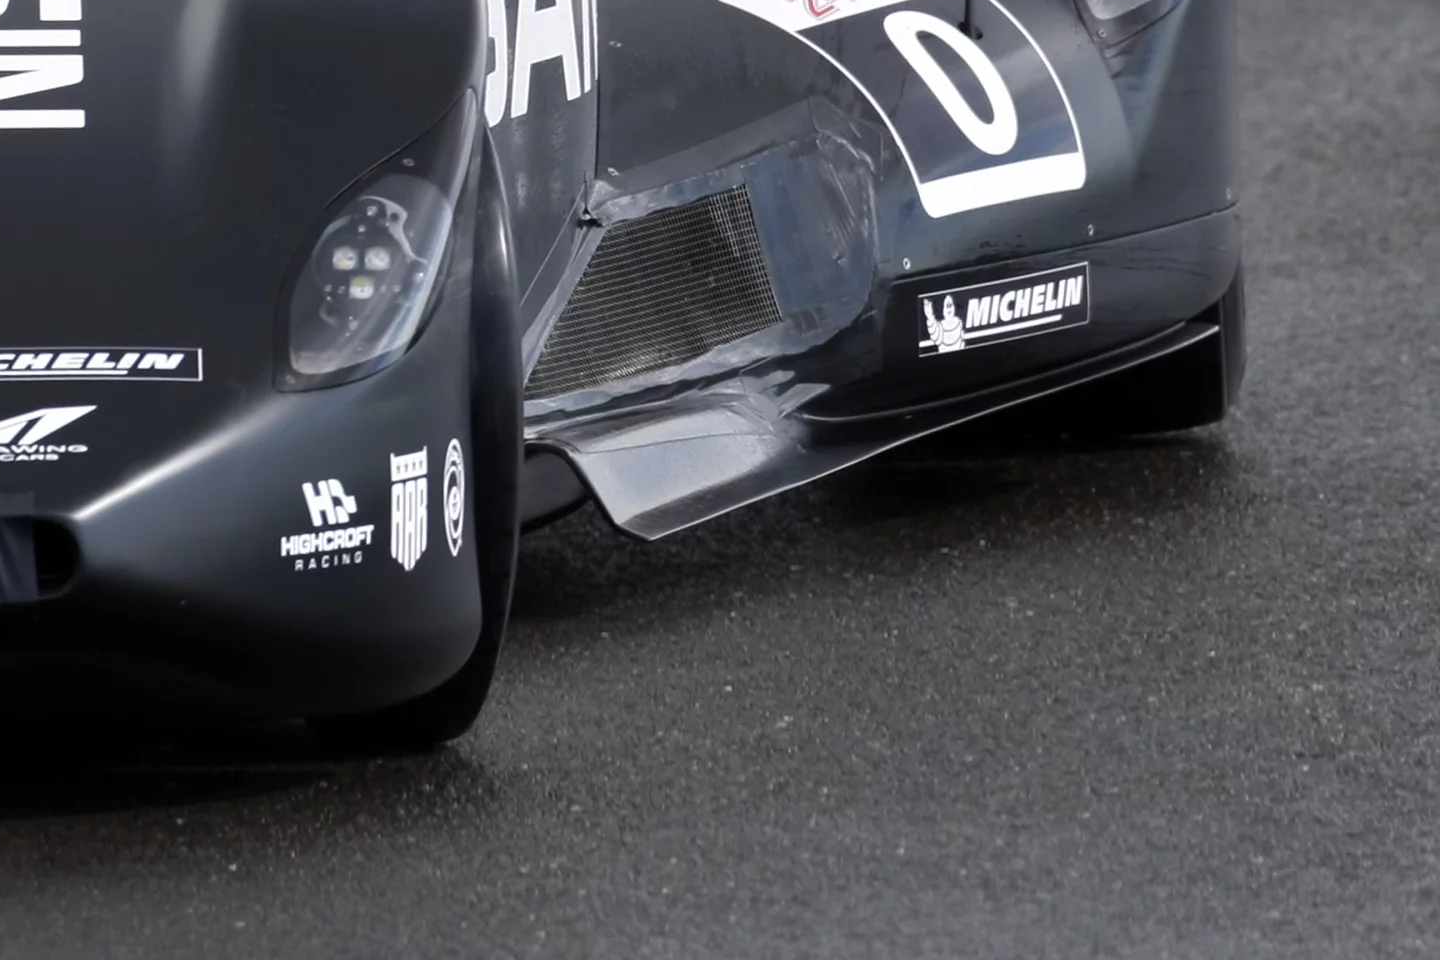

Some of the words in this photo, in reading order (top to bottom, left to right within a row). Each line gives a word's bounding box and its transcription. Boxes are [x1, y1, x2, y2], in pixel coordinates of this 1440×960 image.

[883, 10, 1018, 155] 0
[965, 275, 1084, 329] MICHELIN
[281, 524, 375, 556] HIGHCROFT
[294, 551, 363, 571] RACING
